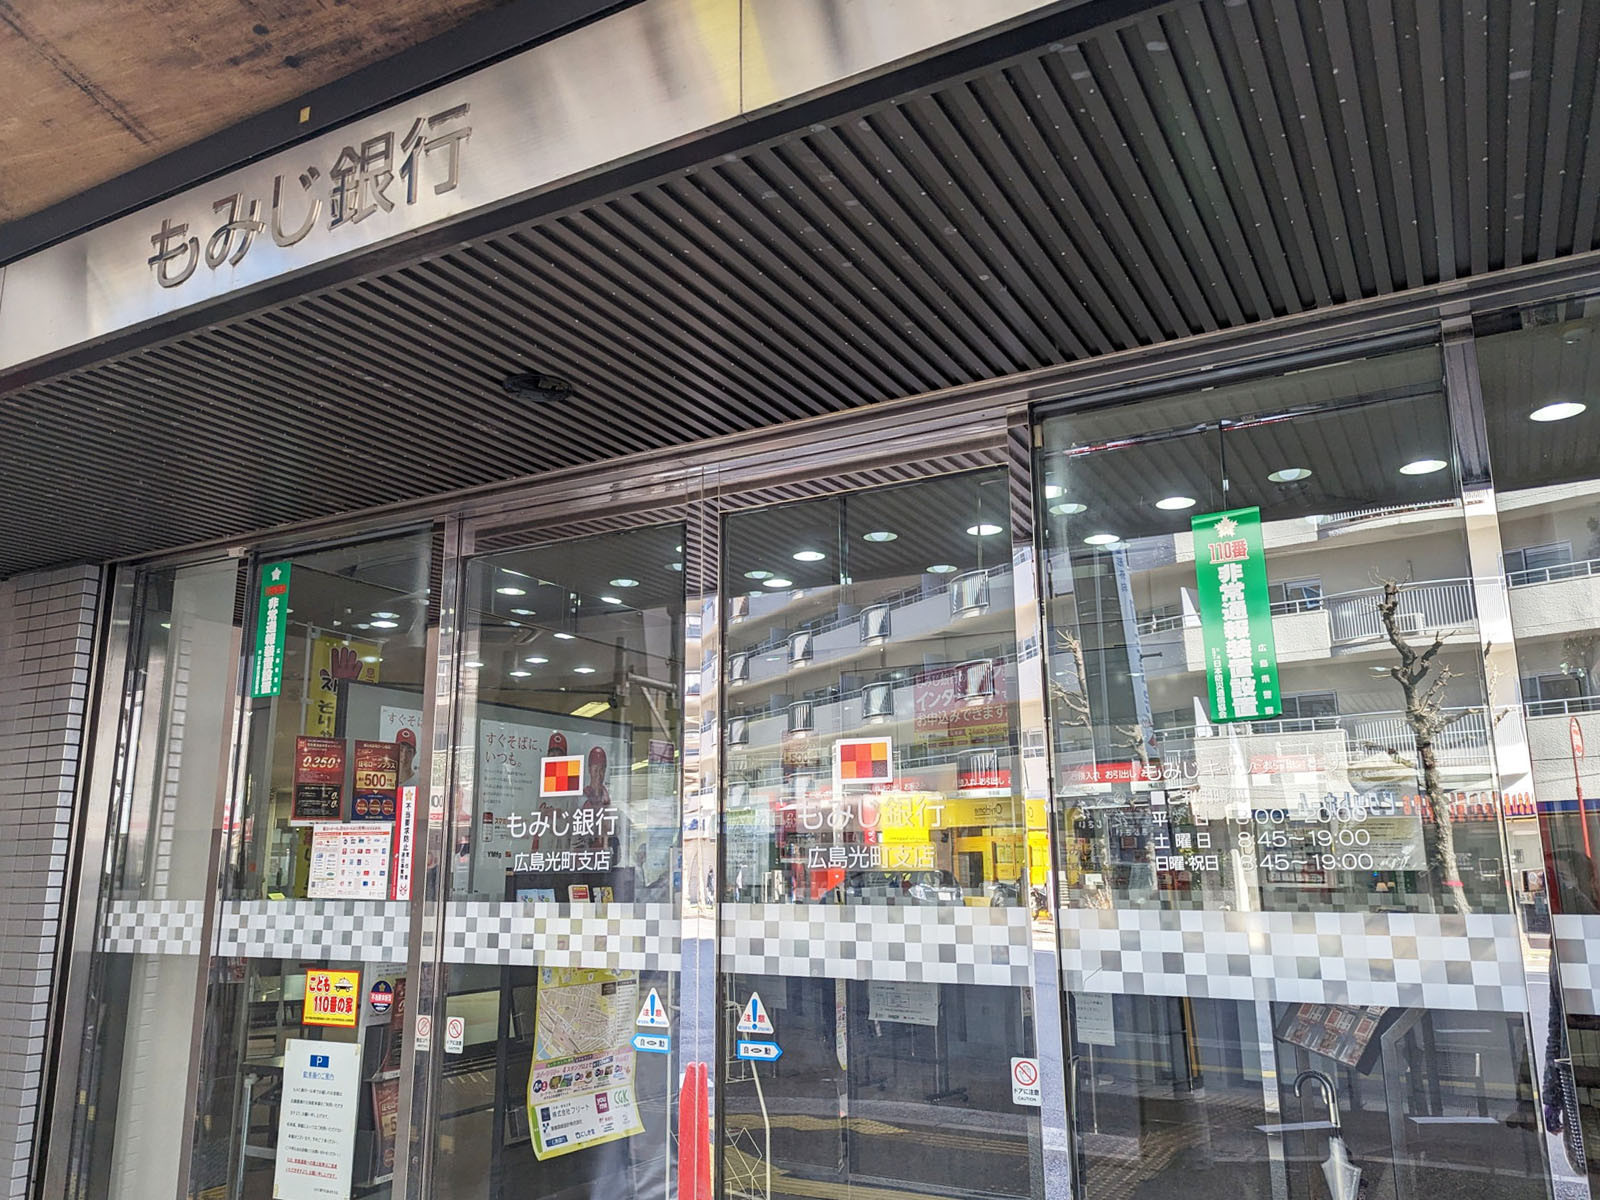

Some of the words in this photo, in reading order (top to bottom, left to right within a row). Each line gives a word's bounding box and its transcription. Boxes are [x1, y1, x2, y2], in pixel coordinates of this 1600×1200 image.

[147, 103, 474, 290] もみじ銀行
[1208, 540, 1248, 562] 110番
[1217, 562, 1259, 717] 非常通報装置設置
[486, 733, 543, 752] すぐそばに、
[364, 773, 387, 787] 500
[507, 807, 618, 838] もみじ銀行
[797, 793, 946, 831] もみじ銀行
[1154, 832, 1211, 849] 土曜日
[513, 850, 611, 872] 広島光町支店
[807, 844, 937, 870] 広島光町支店
[309, 975, 330, 992] こども
[314, 996, 353, 1013] 110番の家
[1014, 1087, 1040, 1096] ドアに注意
